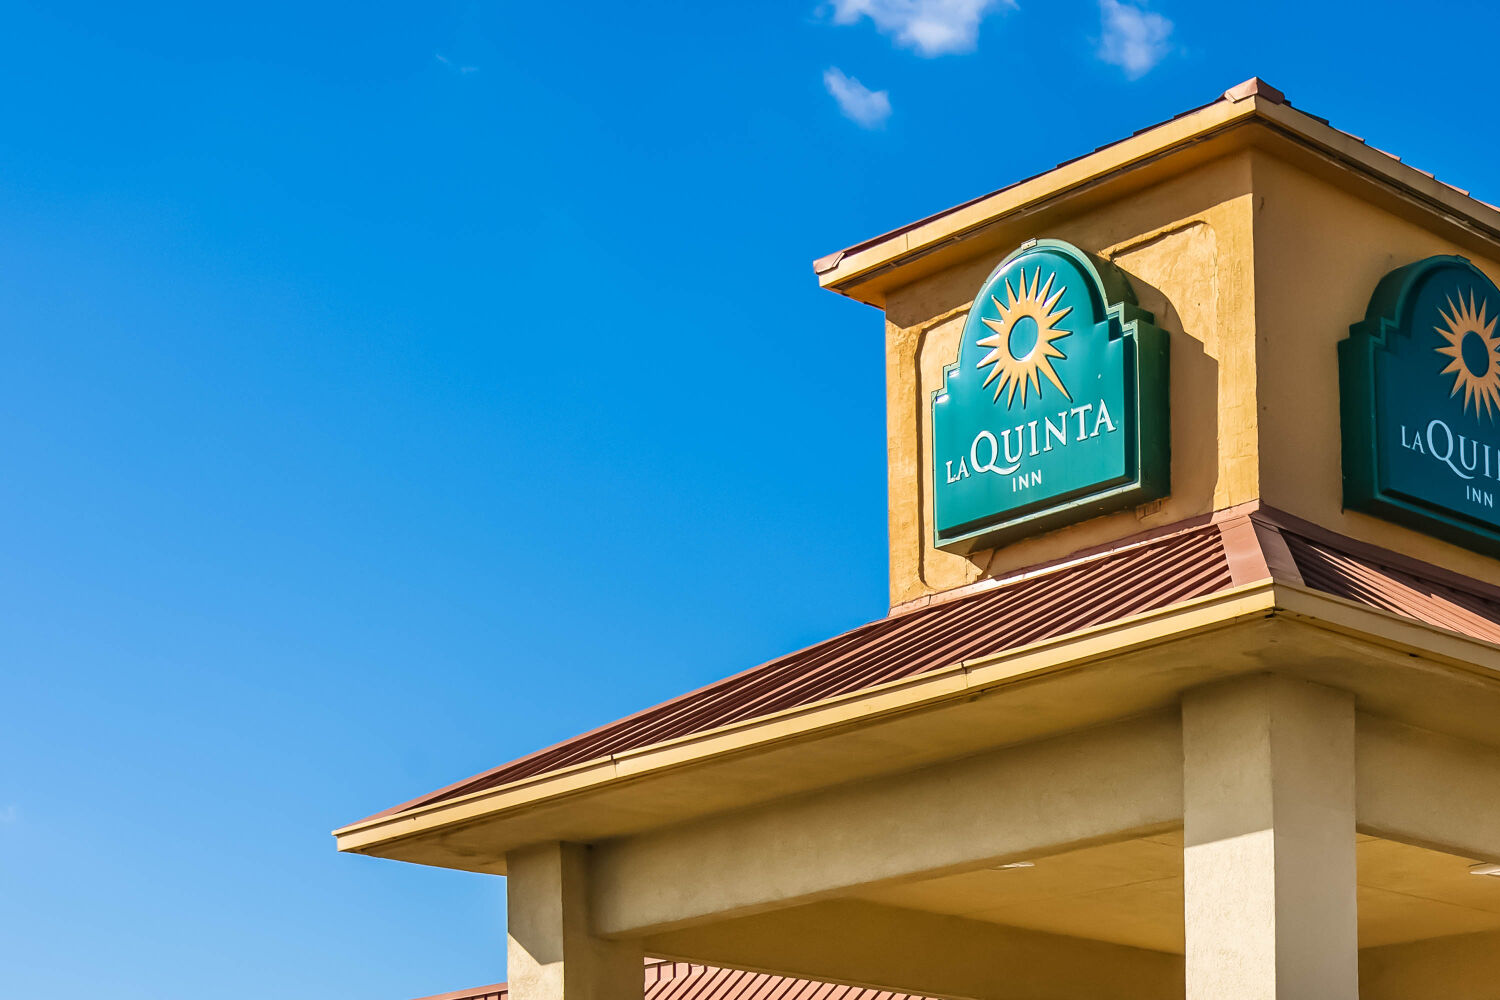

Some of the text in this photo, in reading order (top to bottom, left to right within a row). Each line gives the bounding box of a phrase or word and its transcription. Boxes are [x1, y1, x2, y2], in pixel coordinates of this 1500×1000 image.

[945, 398, 1117, 484] LA QUINTA
[1400, 424, 1425, 455] LA
[1012, 469, 1042, 493] INN
[1466, 485, 1493, 509] INN
